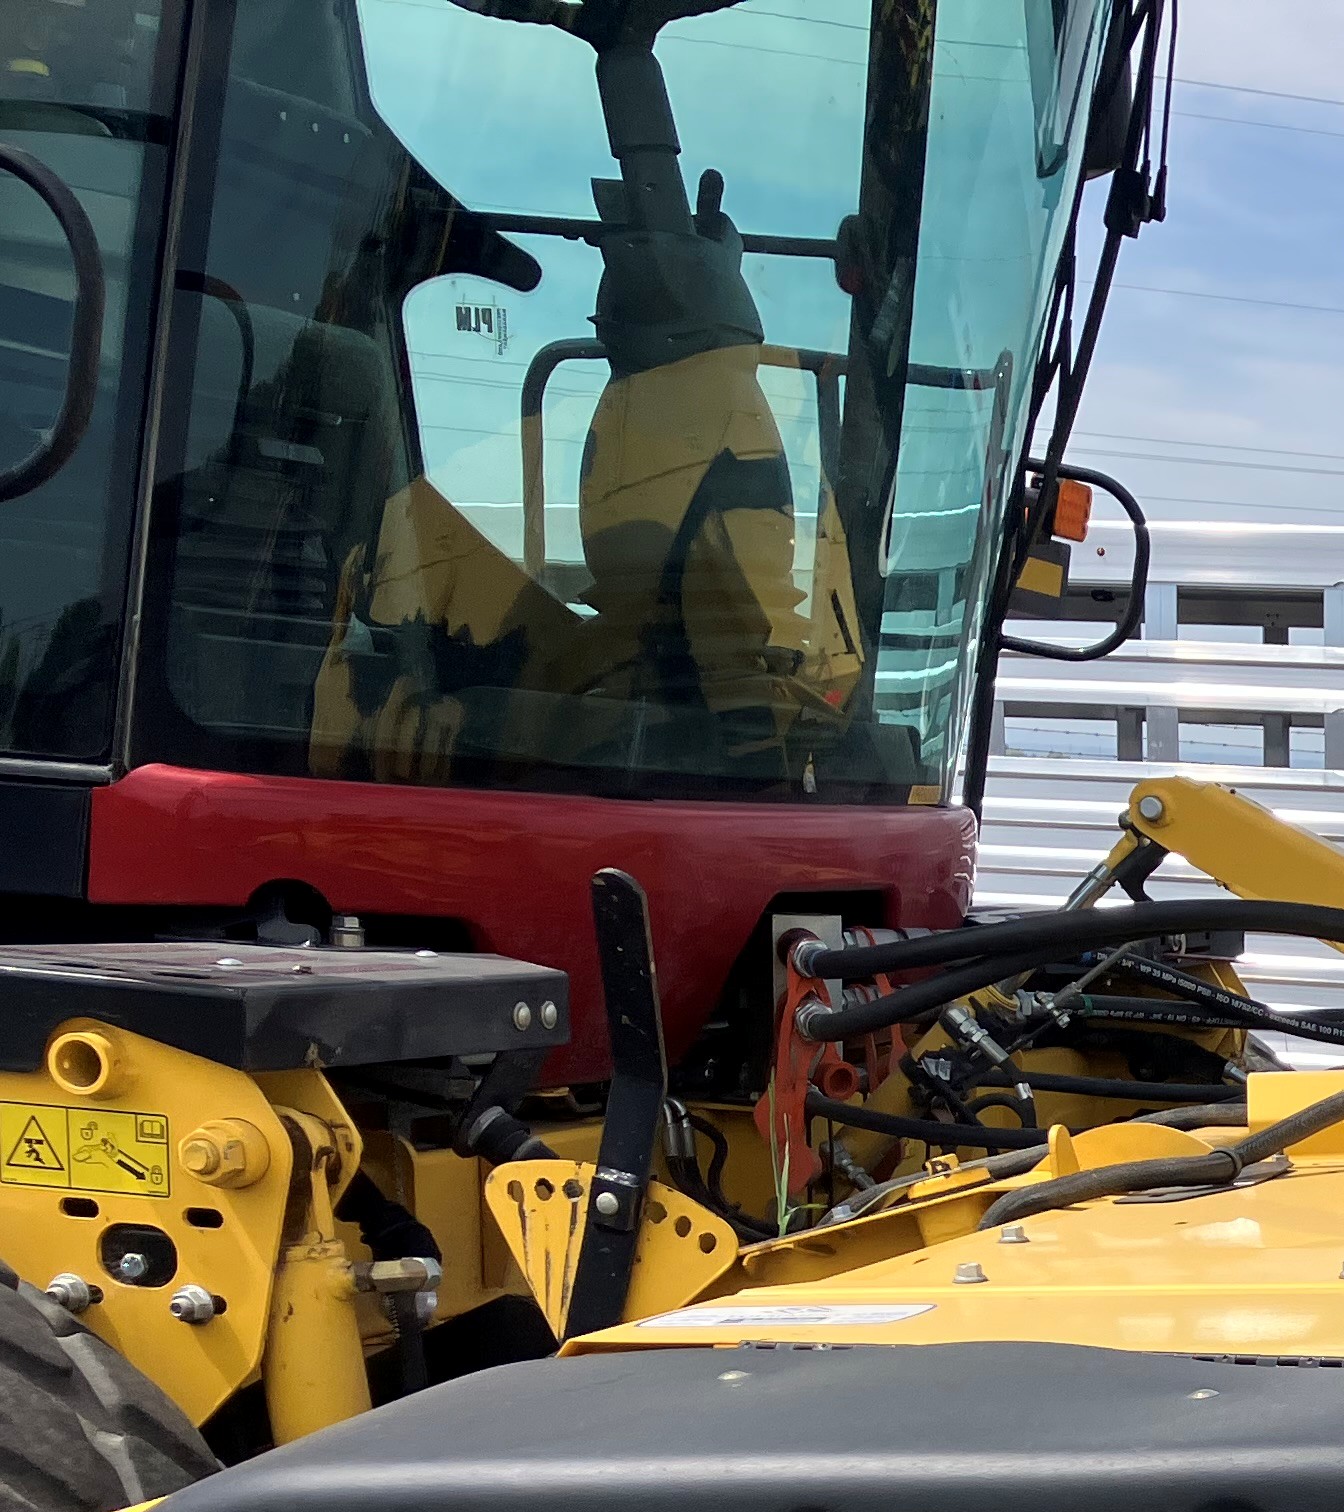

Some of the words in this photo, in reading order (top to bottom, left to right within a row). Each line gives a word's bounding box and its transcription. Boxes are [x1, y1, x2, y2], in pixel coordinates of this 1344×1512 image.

[1216, 992, 1230, 1005] ISO
[1301, 1020, 1317, 1032] SAE
[1319, 1025, 1332, 1035] 100
